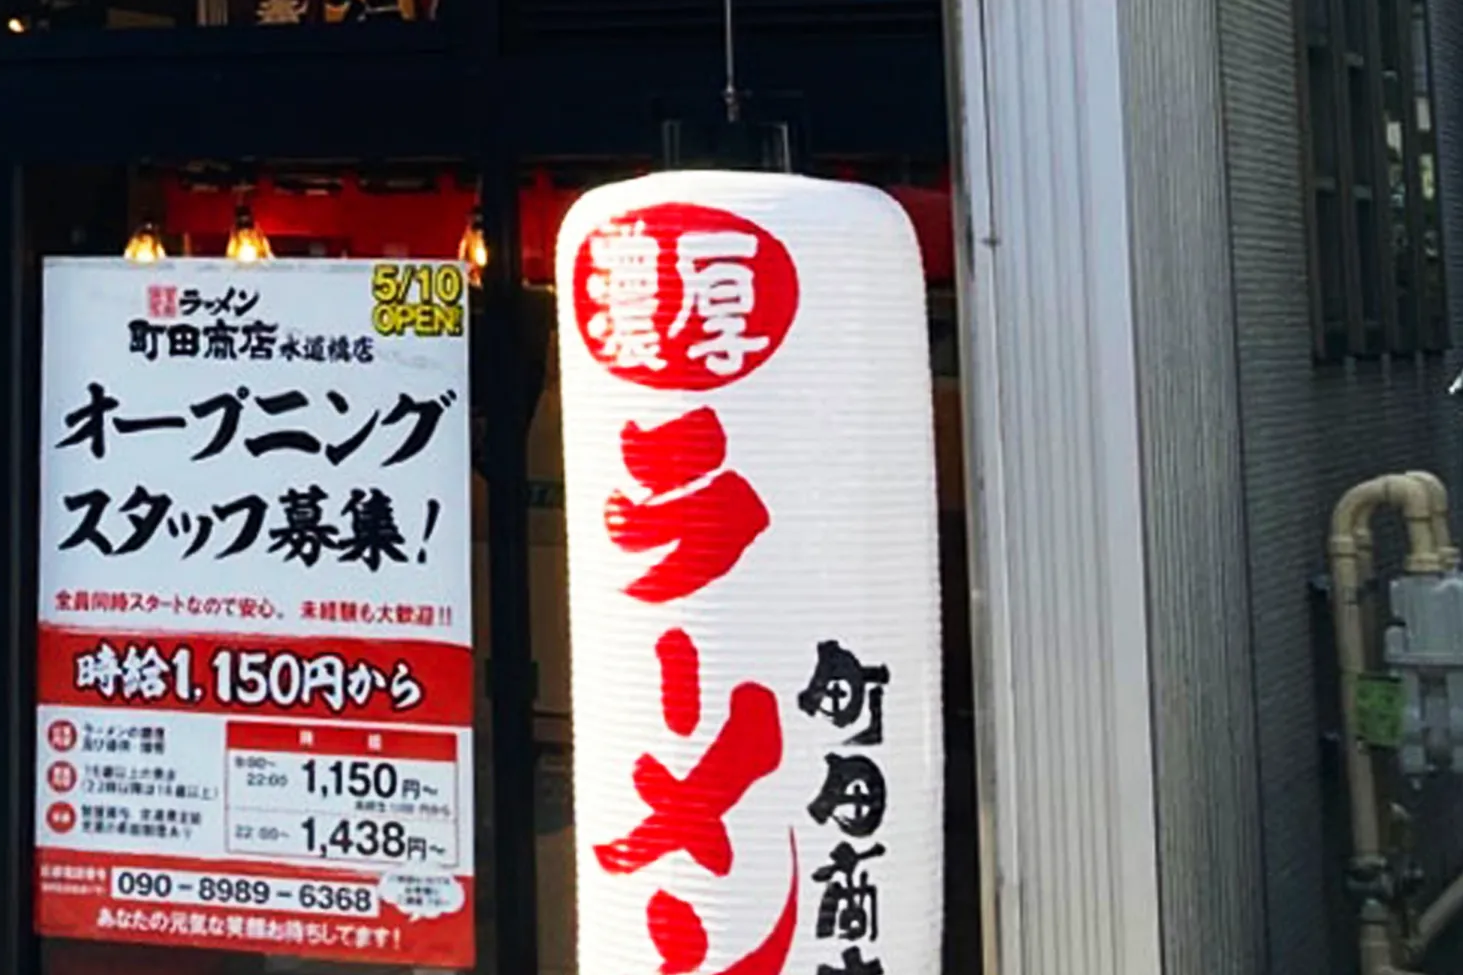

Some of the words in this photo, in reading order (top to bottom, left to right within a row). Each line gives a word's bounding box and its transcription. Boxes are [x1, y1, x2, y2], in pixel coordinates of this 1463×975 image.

[179, 286, 260, 317] ラーメン
[372, 263, 463, 306] 5/10
[587, 219, 771, 376] 濃厚
[128, 319, 279, 361] 町田商店
[279, 334, 374, 364] 水道橋店
[55, 382, 457, 467] オープニング
[58, 485, 440, 572] スタッフ募集!
